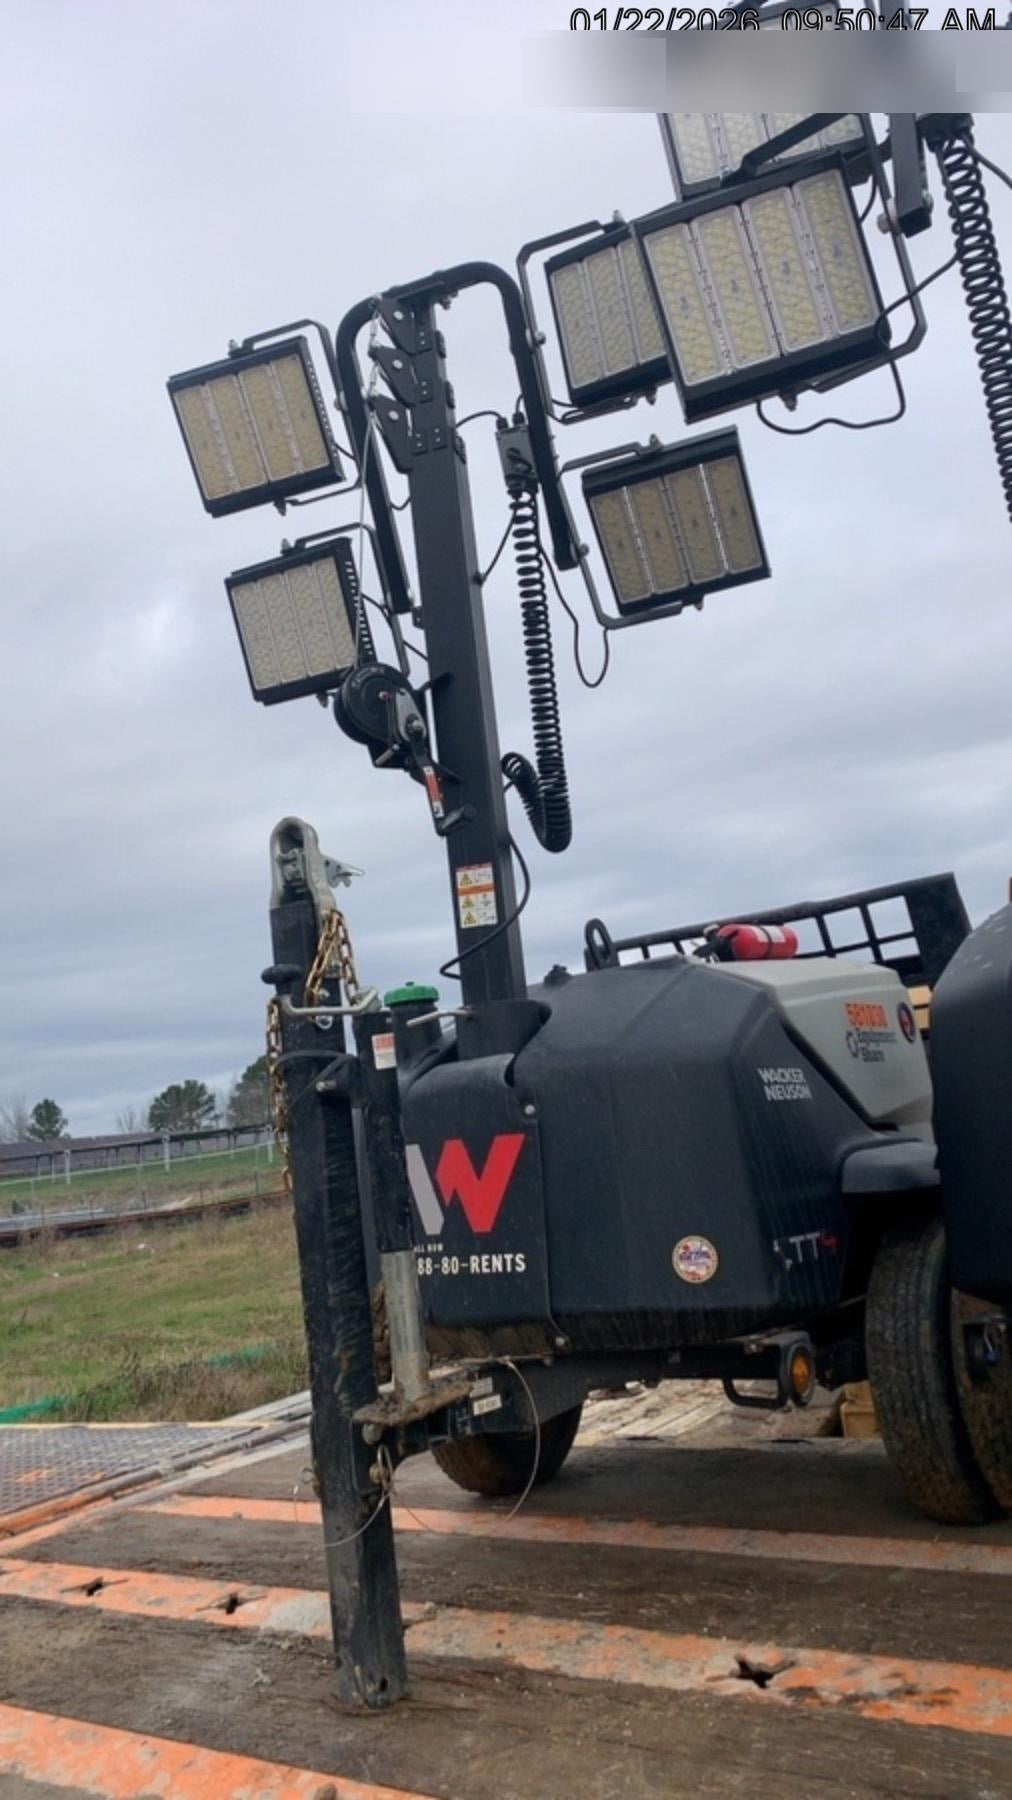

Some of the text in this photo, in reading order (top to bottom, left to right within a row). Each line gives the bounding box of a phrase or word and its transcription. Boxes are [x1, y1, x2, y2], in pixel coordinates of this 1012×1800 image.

[757, 1067, 807, 1084] WACKER
[763, 1083, 813, 1101] NEUSON
[417, 1253, 526, 1276] 88-80-RENTS
